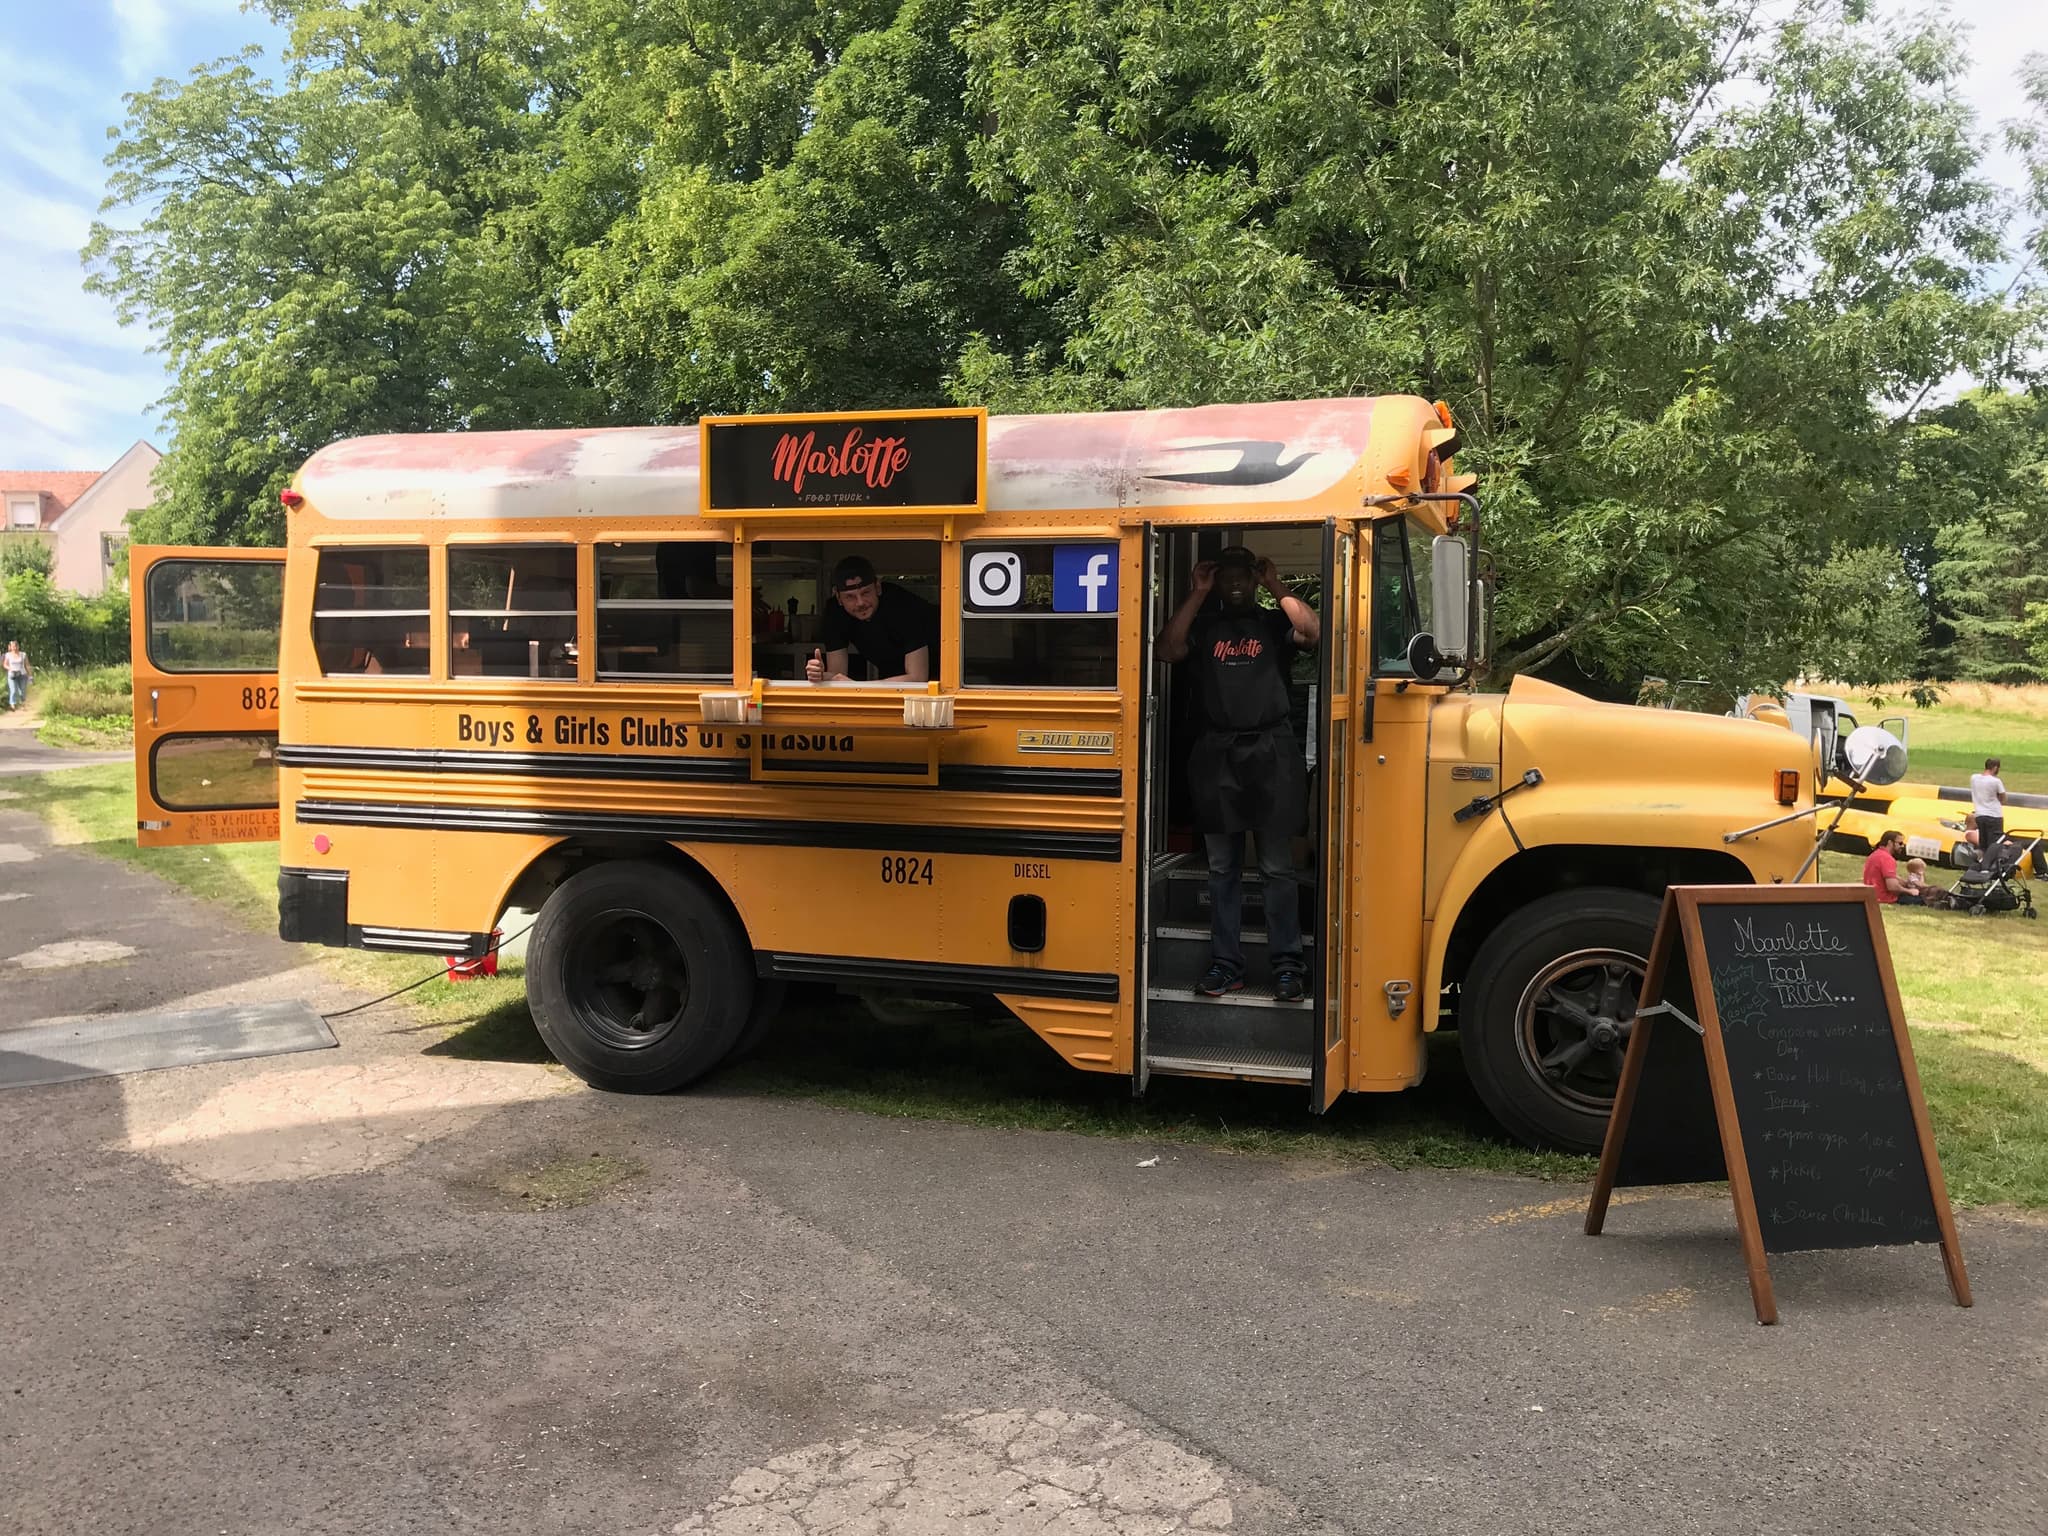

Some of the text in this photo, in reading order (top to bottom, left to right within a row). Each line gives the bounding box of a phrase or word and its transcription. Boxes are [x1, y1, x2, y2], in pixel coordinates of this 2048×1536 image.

[771, 427, 911, 494] Marlotte
[805, 493, 863, 502] FOOD TRUCK
[1212, 638, 1264, 661] Marlotte
[458, 714, 515, 746] Boys
[526, 715, 543, 744] &
[554, 716, 610, 746] Girls
[620, 717, 689, 747] Clubs
[1041, 734, 1110, 747] BLUE BIRD
[881, 856, 933, 885] 8824
[1014, 863, 1051, 879] DIESEL
[1734, 916, 1848, 952] Marlotte
[1767, 957, 1808, 981] Food
